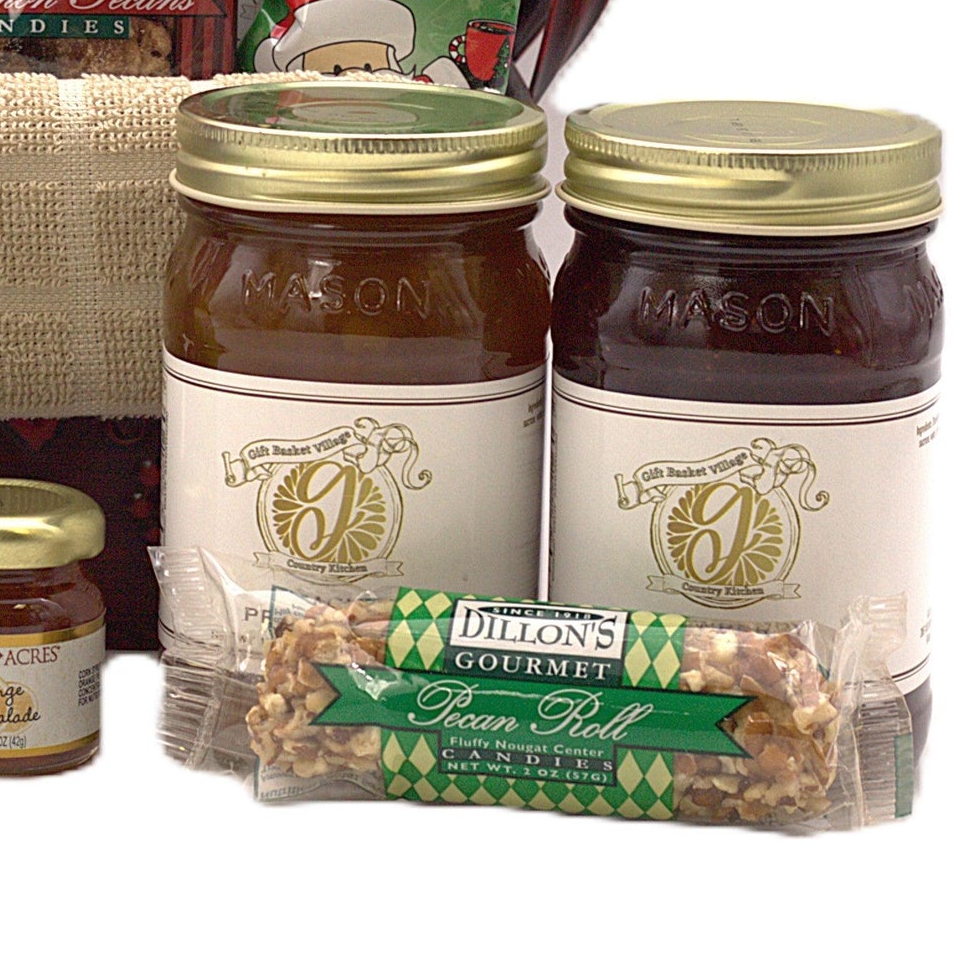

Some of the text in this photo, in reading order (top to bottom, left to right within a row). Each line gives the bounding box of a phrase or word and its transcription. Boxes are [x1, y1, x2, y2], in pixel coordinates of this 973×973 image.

[240, 267, 429, 319] MASON
[637, 285, 834, 336] MASON
[247, 430, 352, 460] Gift Basket Village
[641, 451, 748, 482] Gift Basket Village
[286, 558, 368, 574] Country Kitchen
[682, 581, 765, 597] Country Kitchen
[493, 607, 592, 620] SINCE 1918
[458, 606, 619, 652] DILLON'S
[454, 651, 611, 680] GOURMET
[407, 679, 654, 740] Pecan Roll
[9, 735, 27, 748] (42g)
[450, 736, 604, 757] Fluffy Nougat Center
[441, 748, 613, 772] CANDIES
[447, 761, 608, 783] NET WT. 2 OZ (57G)
